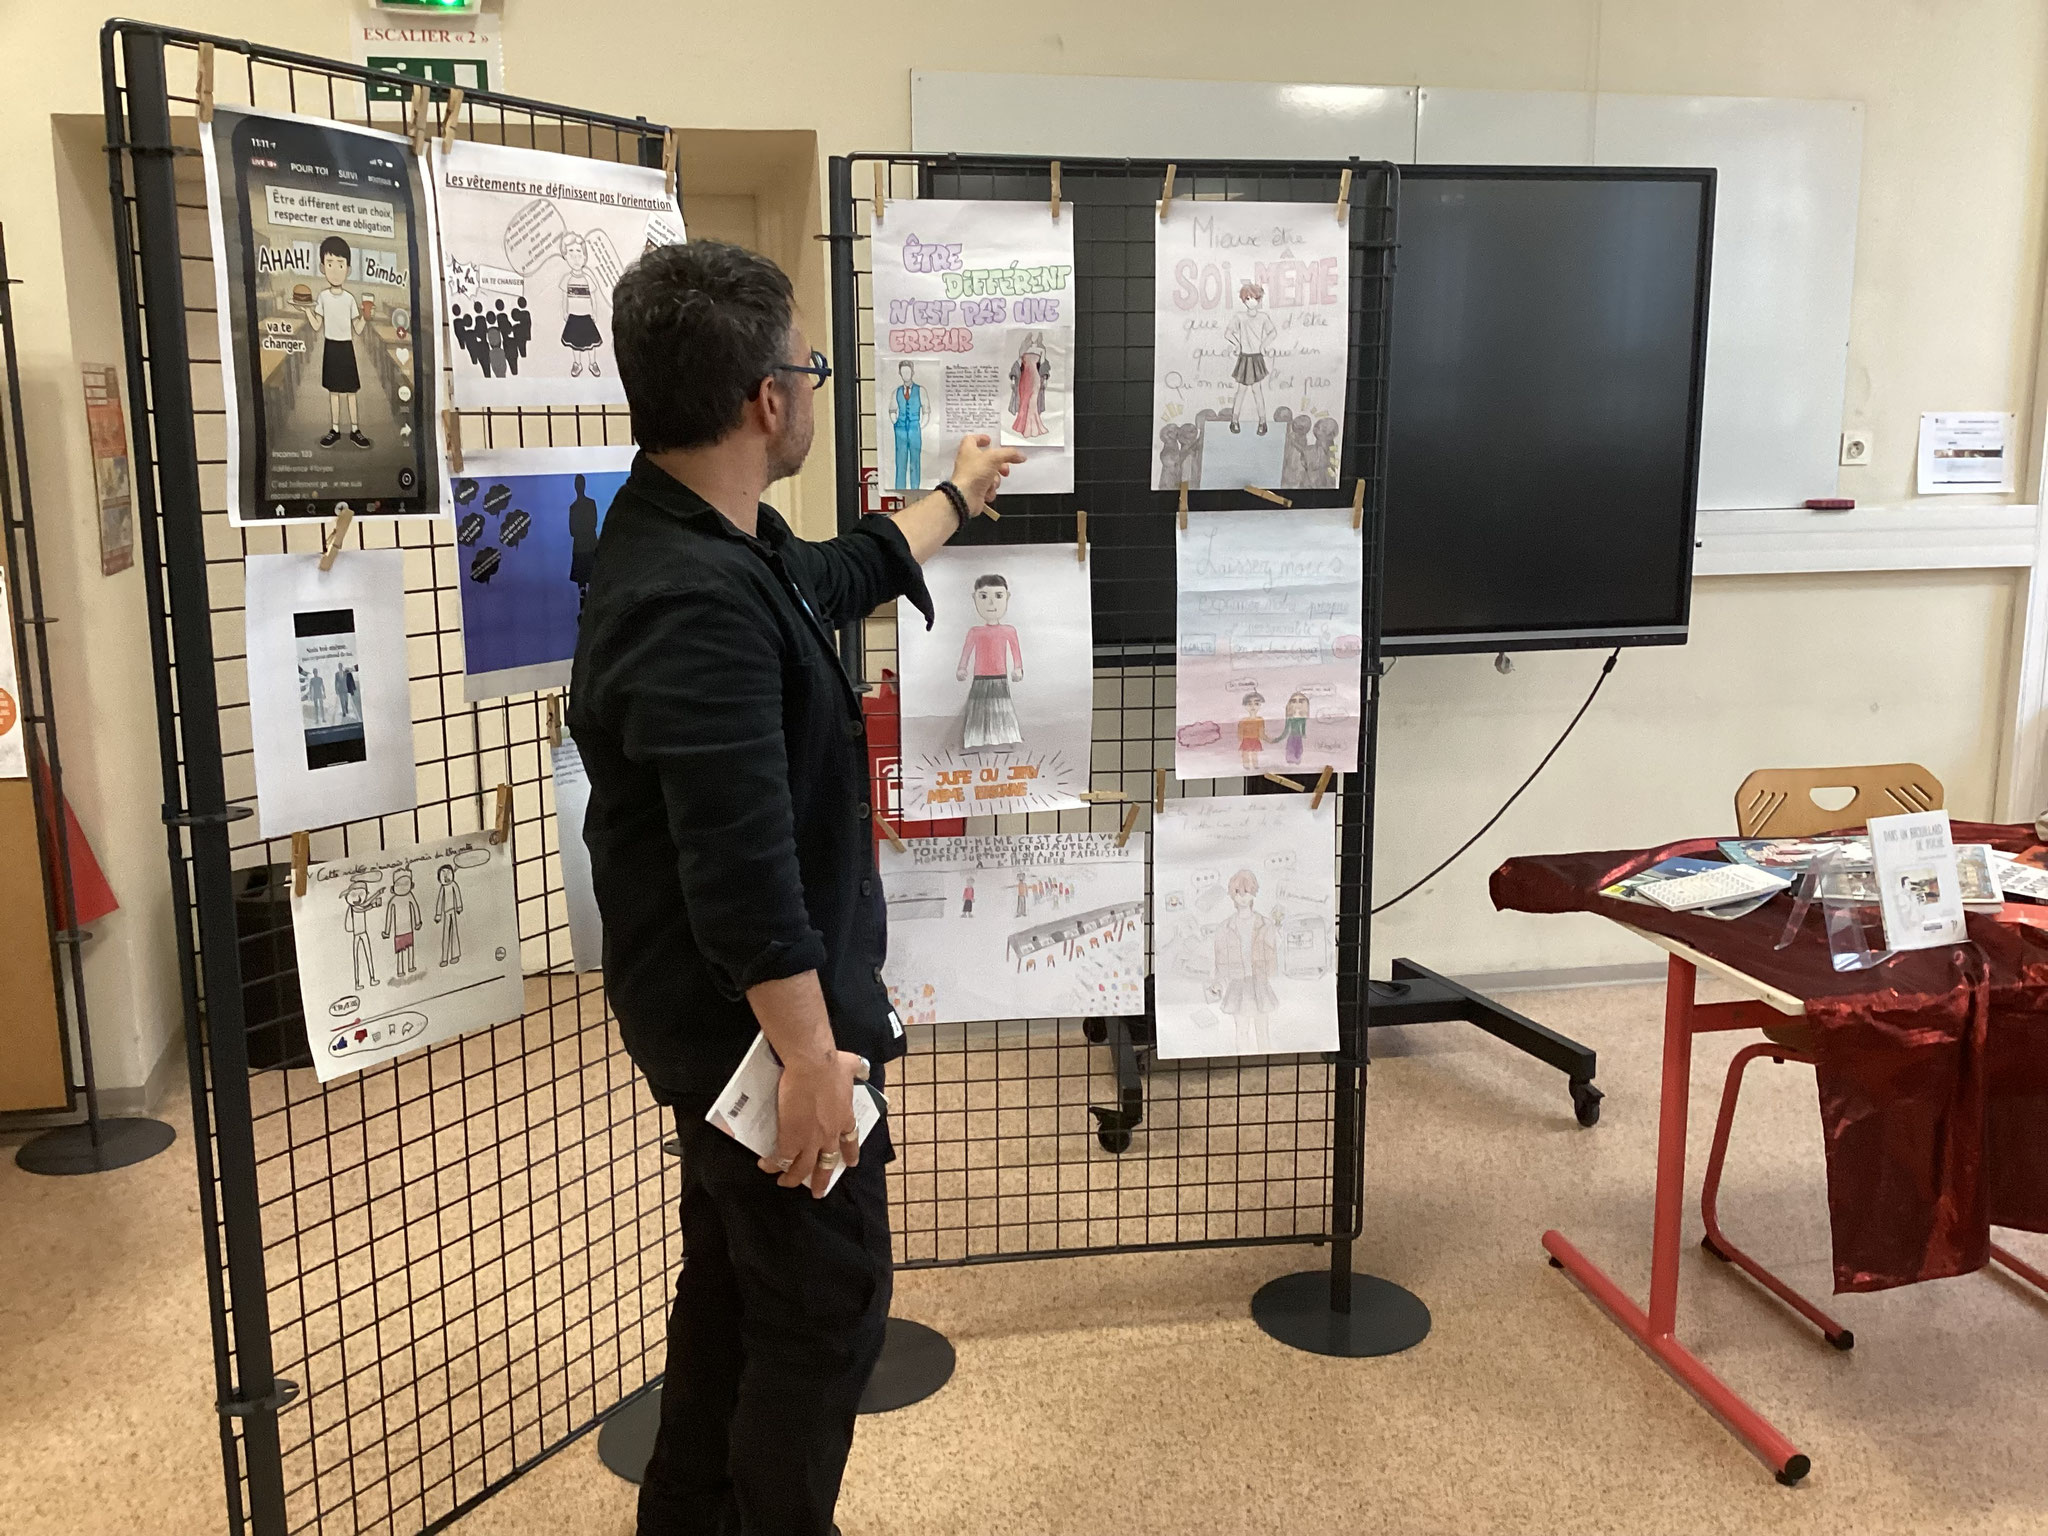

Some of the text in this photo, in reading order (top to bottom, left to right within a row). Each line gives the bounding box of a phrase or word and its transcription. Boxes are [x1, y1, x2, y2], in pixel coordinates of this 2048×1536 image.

[364, 28, 451, 42] ESCALIER
[468, 31, 476, 43] 2
[290, 162, 328, 175] POUR TOI
[338, 169, 358, 180] SUIVI
[446, 172, 673, 212] Les vêtements ne définissent pas l'orientation
[272, 189, 295, 205] Être
[298, 197, 340, 211] différent
[342, 204, 356, 214] est
[358, 207, 368, 215] un
[274, 209, 318, 224] respecter
[320, 217, 334, 225] est
[336, 219, 351, 227] une
[259, 246, 310, 272] AHAH!
[903, 232, 963, 273] ÊTRE
[497, 278, 524, 286] CHANGER
[889, 297, 1060, 327] N'EST PAS UNE
[267, 322, 293, 333] va te
[1183, 318, 1219, 341] que
[263, 338, 306, 353] changer.
[889, 327, 974, 353] ERREUR
[1303, 376, 1332, 397] pas
[980, 768, 999, 782] OU
[907, 838, 939, 848] ETRE
[1077, 833, 1093, 842] LA
[1883, 829, 1899, 842] DANS
[1900, 830, 1908, 840] UN
[1052, 842, 1098, 851] AUTRES
